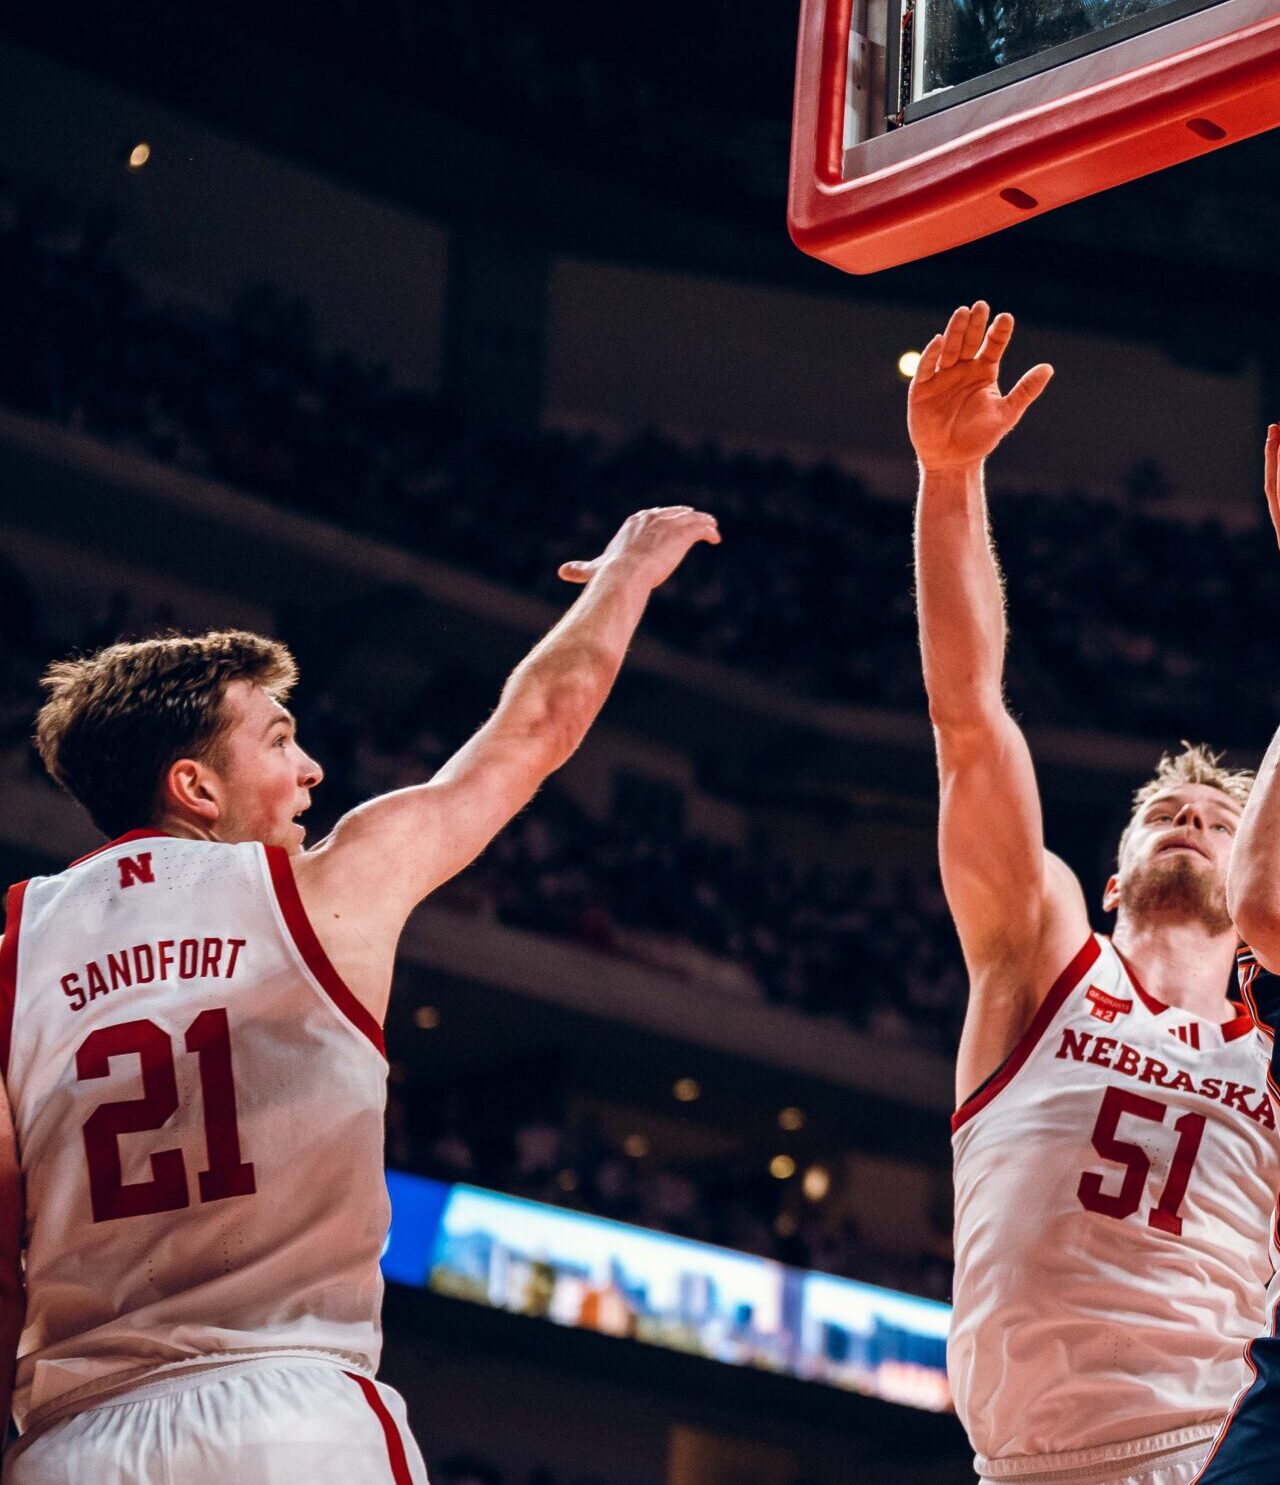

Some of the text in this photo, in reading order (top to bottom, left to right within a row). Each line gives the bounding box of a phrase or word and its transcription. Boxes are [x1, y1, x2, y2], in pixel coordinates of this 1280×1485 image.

[117, 851, 155, 889] N
[60, 937, 246, 1011] SANDFORT
[75, 1007, 257, 1223] 21
[1054, 1027, 1277, 1131] NEBRASKA
[1077, 1085, 1207, 1237] 51
